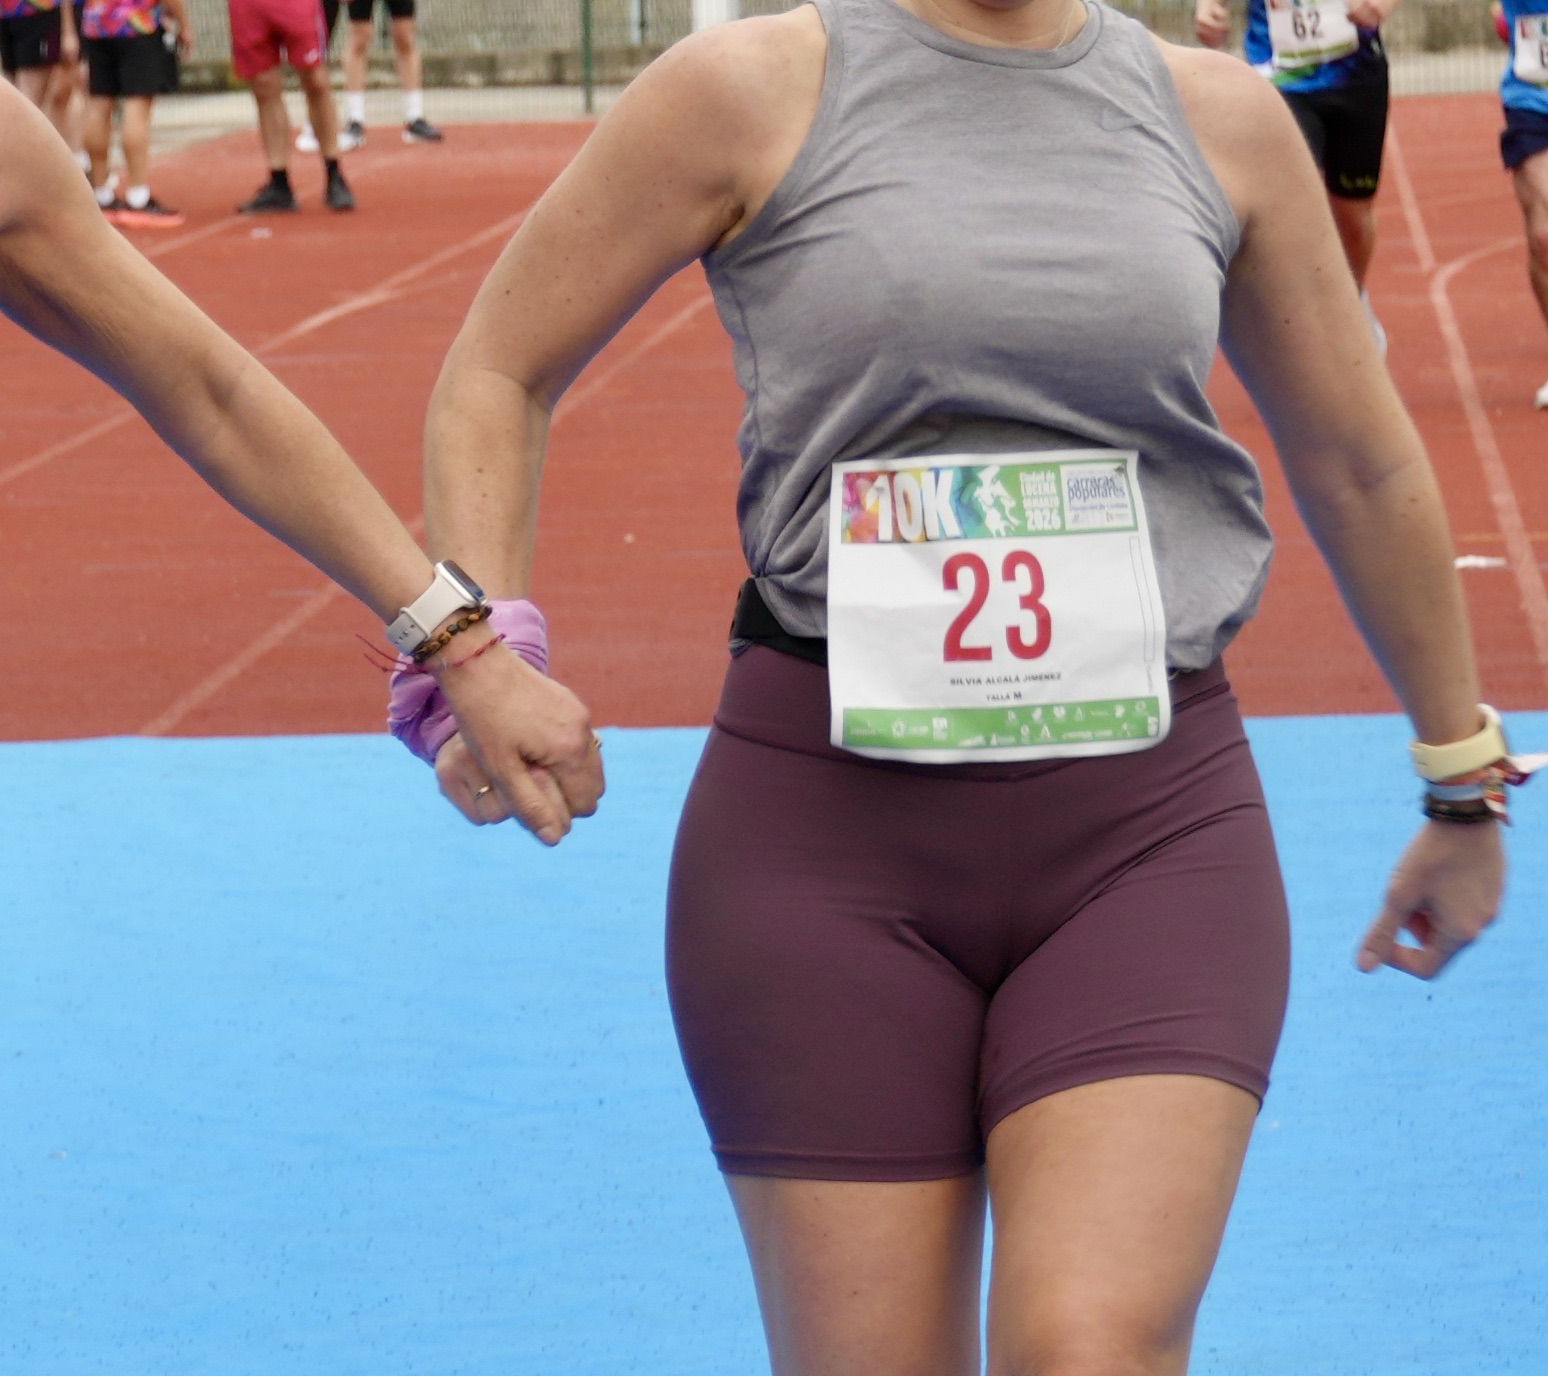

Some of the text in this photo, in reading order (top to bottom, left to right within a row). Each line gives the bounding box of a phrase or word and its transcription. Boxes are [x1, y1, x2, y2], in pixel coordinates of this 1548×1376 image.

[864, 469, 964, 543] 10K
[942, 550, 1052, 662] 23
[950, 676, 982, 686] SILVIA
[986, 691, 1022, 702] TALLA M
